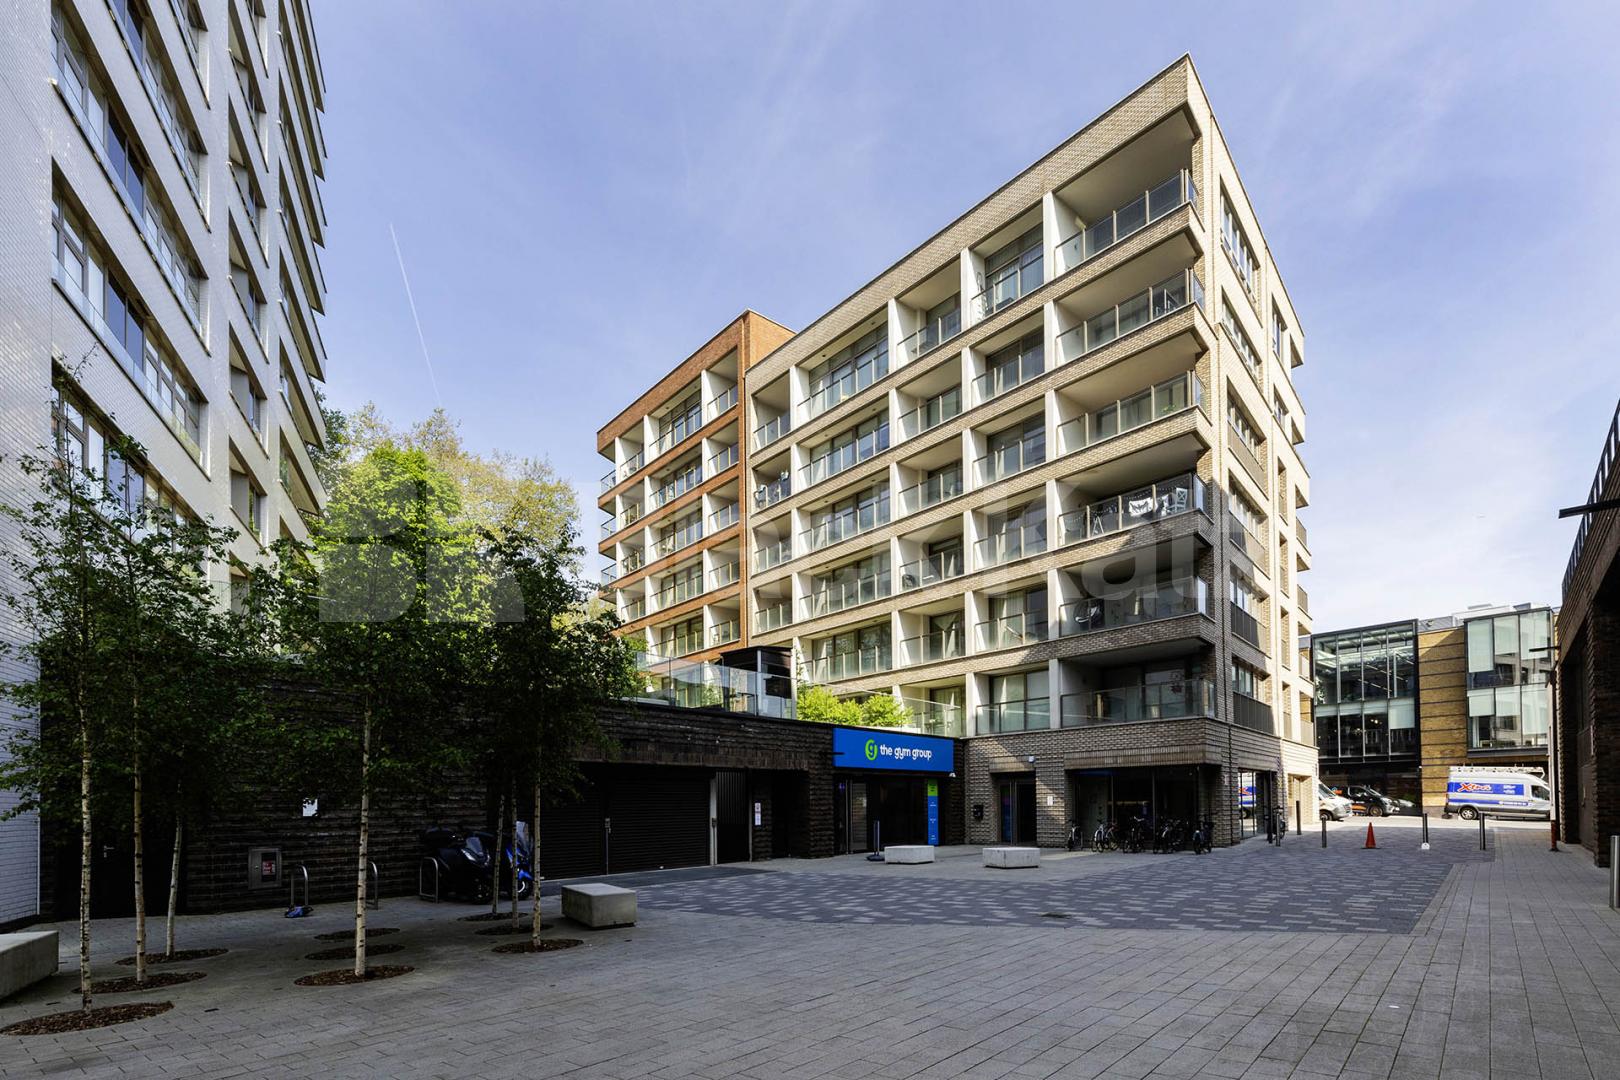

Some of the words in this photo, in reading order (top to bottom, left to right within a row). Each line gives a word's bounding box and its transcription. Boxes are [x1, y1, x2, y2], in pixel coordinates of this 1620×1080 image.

[880, 744, 893, 756] the
[894, 747, 911, 760] gym
[912, 748, 932, 761] group
